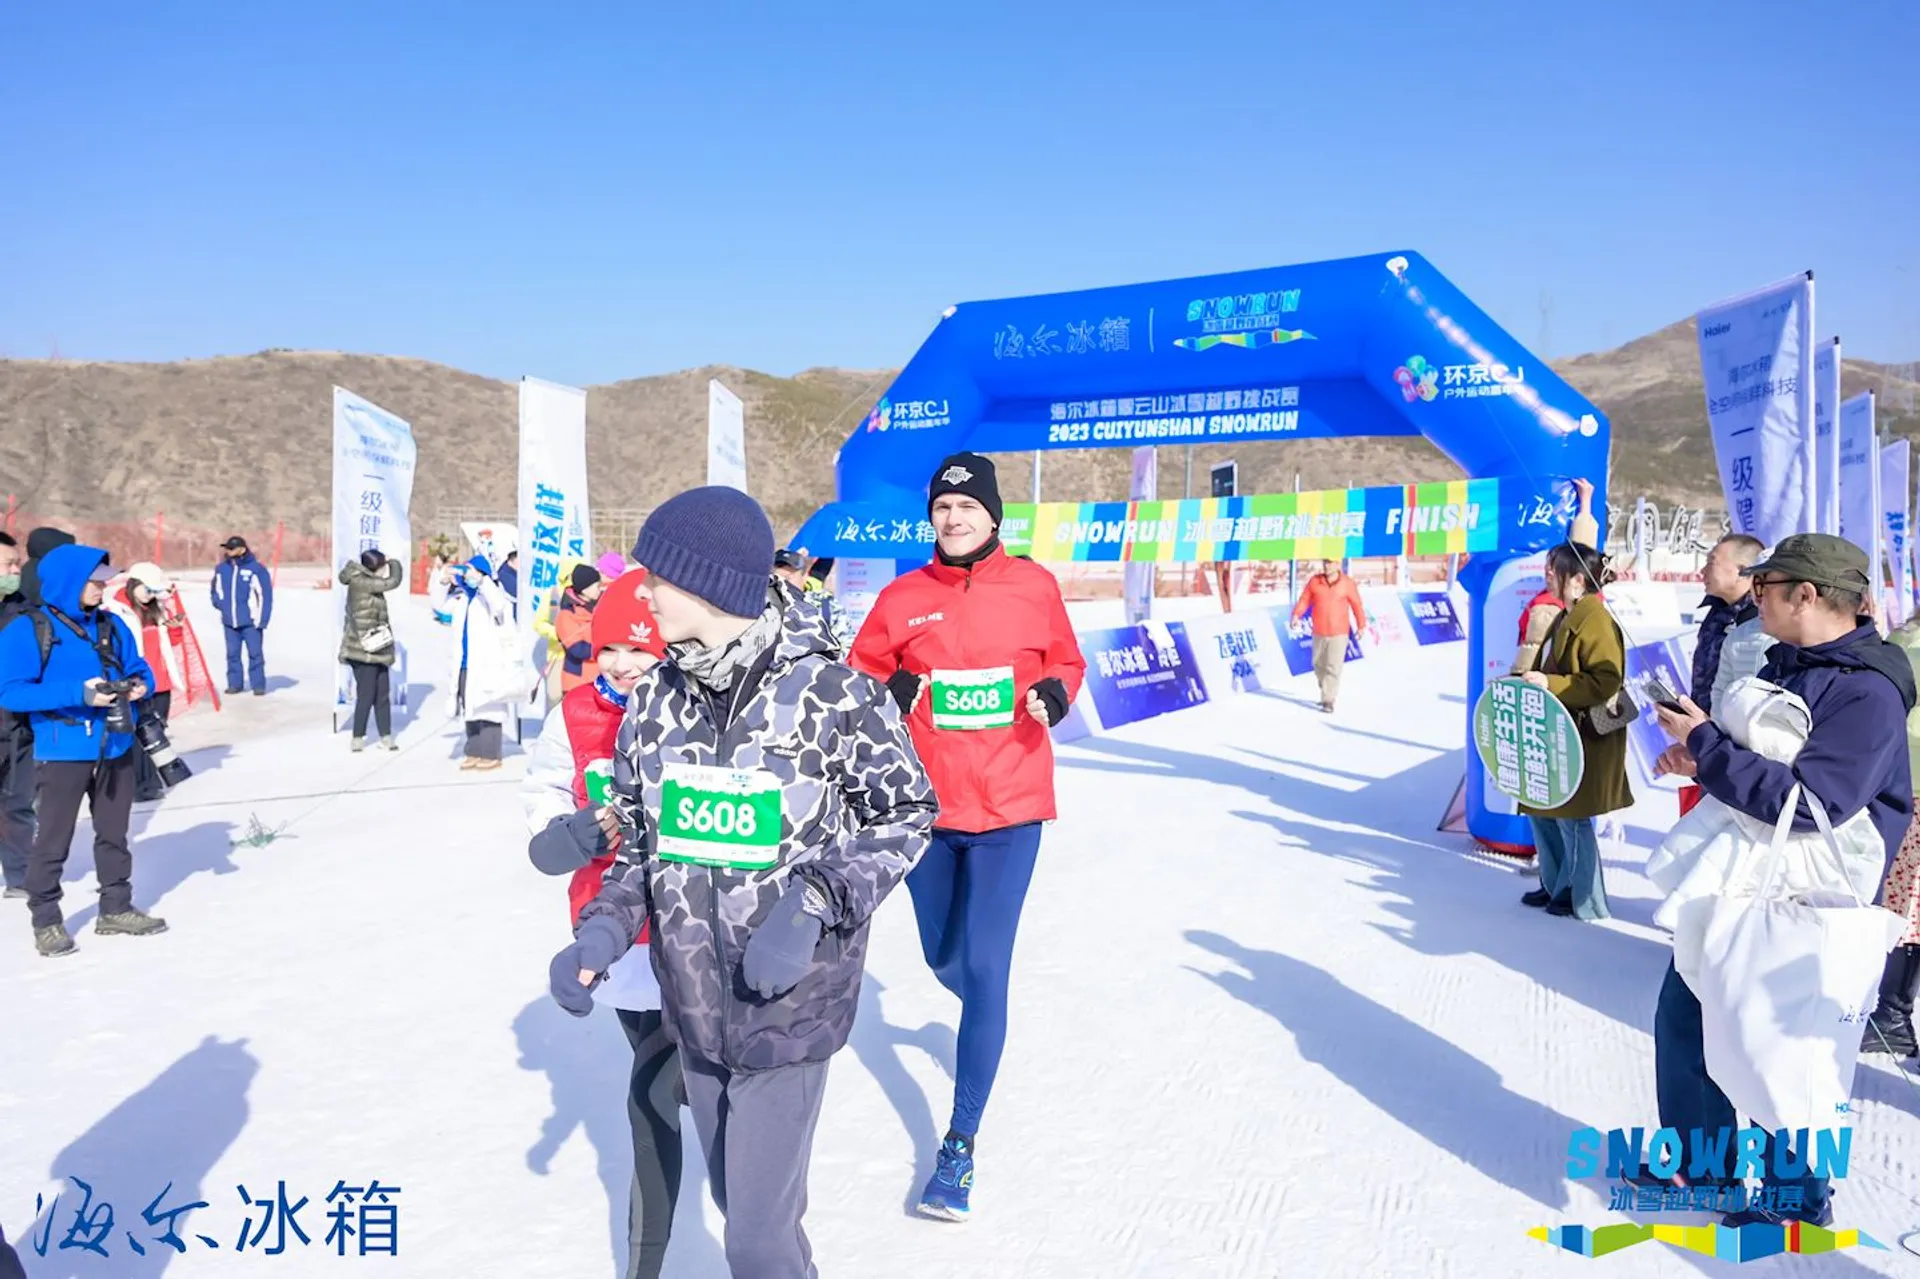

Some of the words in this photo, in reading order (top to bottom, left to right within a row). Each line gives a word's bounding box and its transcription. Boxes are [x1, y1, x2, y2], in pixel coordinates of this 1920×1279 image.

[1187, 289, 1301, 321] SNOWRUN
[994, 316, 1131, 360] 海尔冰箱
[1704, 322, 1731, 338] Haier
[1443, 363, 1524, 386] 环京CJ
[893, 400, 949, 420] 环京CJ
[1048, 423, 1090, 442] 2023
[1093, 416, 1206, 440] CUIYUNSHAN
[1209, 410, 1299, 435] SNOWRUN
[834, 516, 937, 543] 海尔冰箱
[1055, 520, 1174, 544] SNOWRUN
[1182, 510, 1366, 543] 冰雪越野挑战赛
[1385, 503, 1480, 535] FINISH
[908, 612, 944, 627] KELME
[945, 687, 1001, 711] S608
[1480, 712, 1491, 748] Haier
[1491, 681, 1521, 796] 健康生活
[1520, 687, 1550, 805] 新鲜开跑
[676, 796, 758, 837] S608
